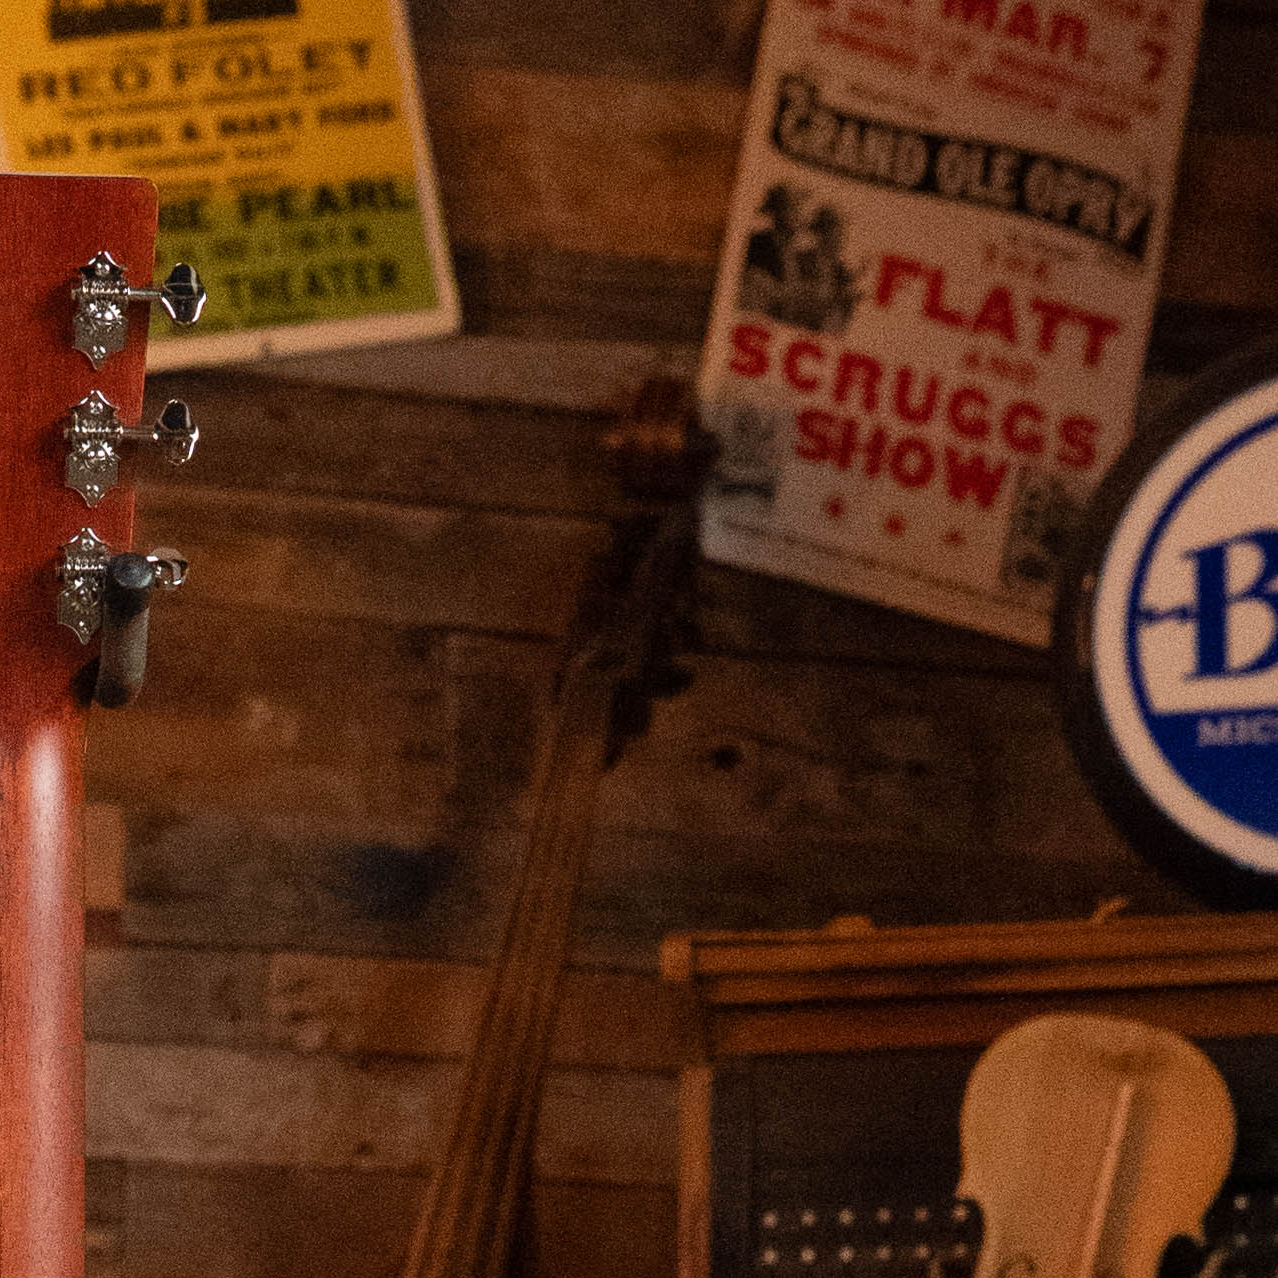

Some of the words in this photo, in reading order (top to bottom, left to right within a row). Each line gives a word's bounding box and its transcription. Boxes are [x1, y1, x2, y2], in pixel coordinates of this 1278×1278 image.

[936, 140, 1018, 204] OLE
[1026, 155, 1153, 246] OPRY
[875, 253, 1121, 370] FLATT
[728, 322, 1101, 470] SCRUGGS
[796, 407, 1008, 508] SHOW
